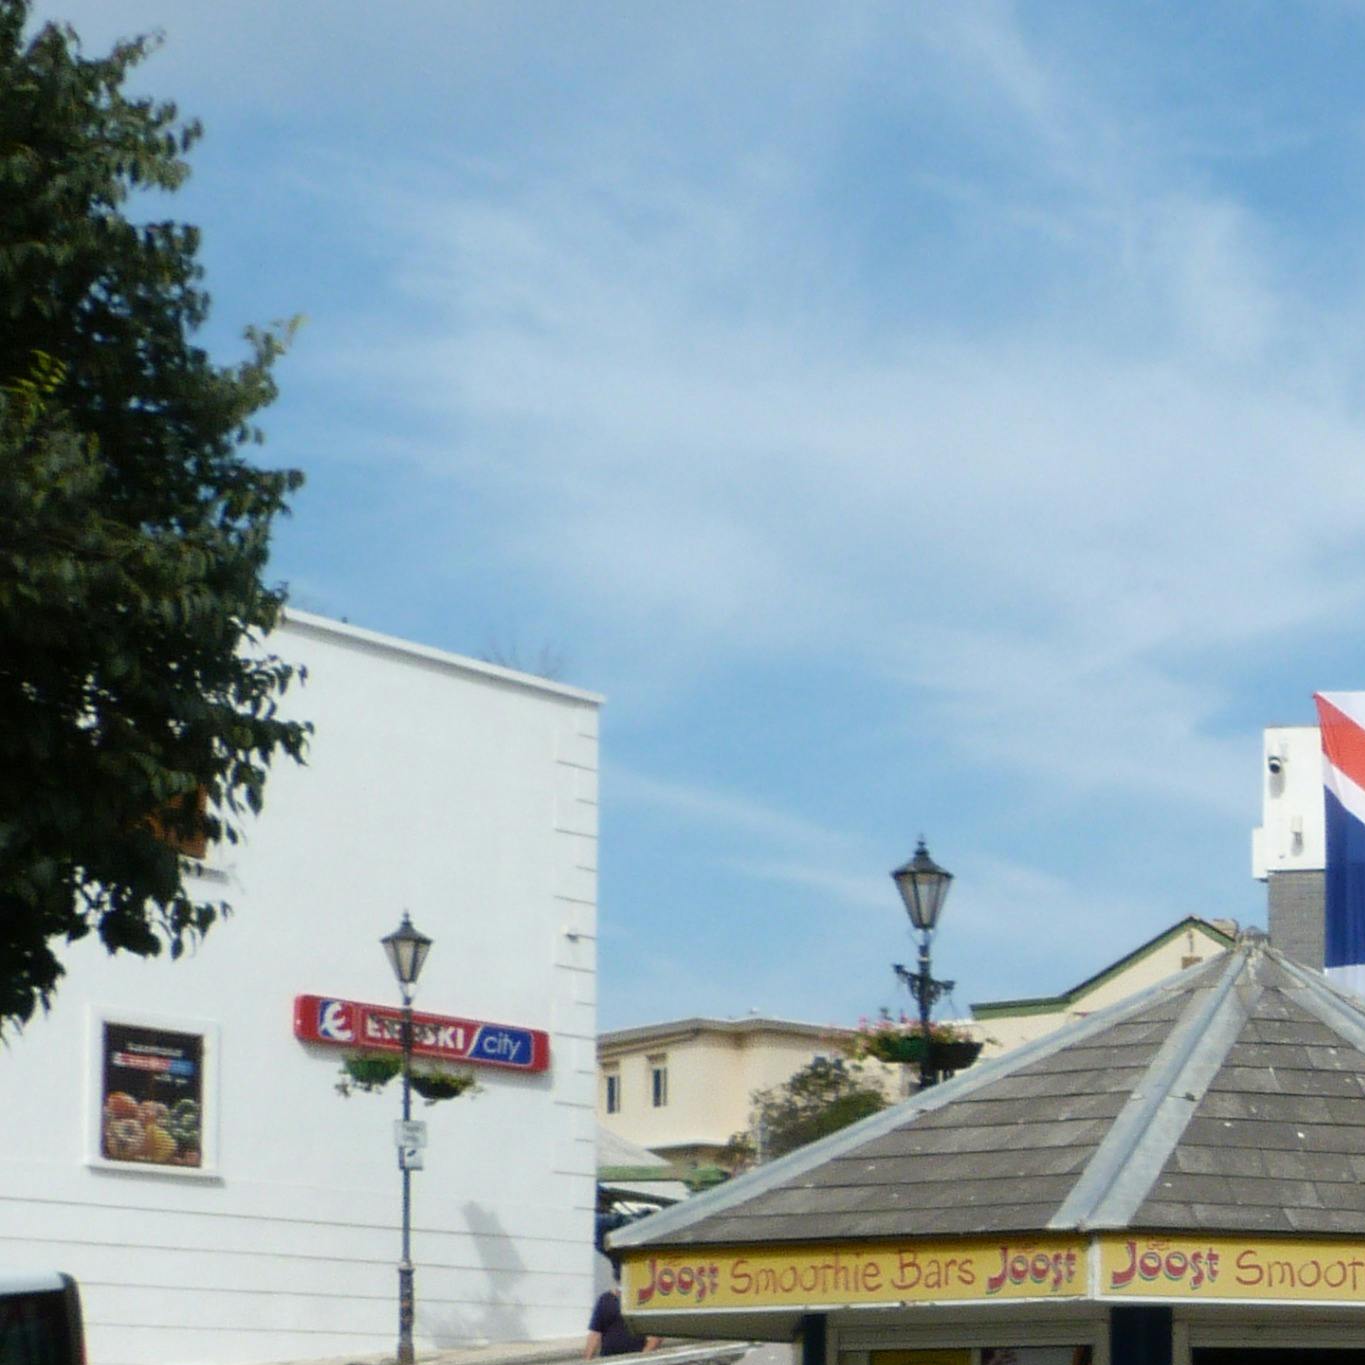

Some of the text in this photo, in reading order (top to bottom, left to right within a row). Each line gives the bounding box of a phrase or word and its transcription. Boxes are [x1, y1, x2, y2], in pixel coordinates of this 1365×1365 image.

[483, 1034, 521, 1060] city
[637, 1245, 1076, 1304] Joost Smoothie Bars Joost
[1110, 1240, 1219, 1289] Joost
